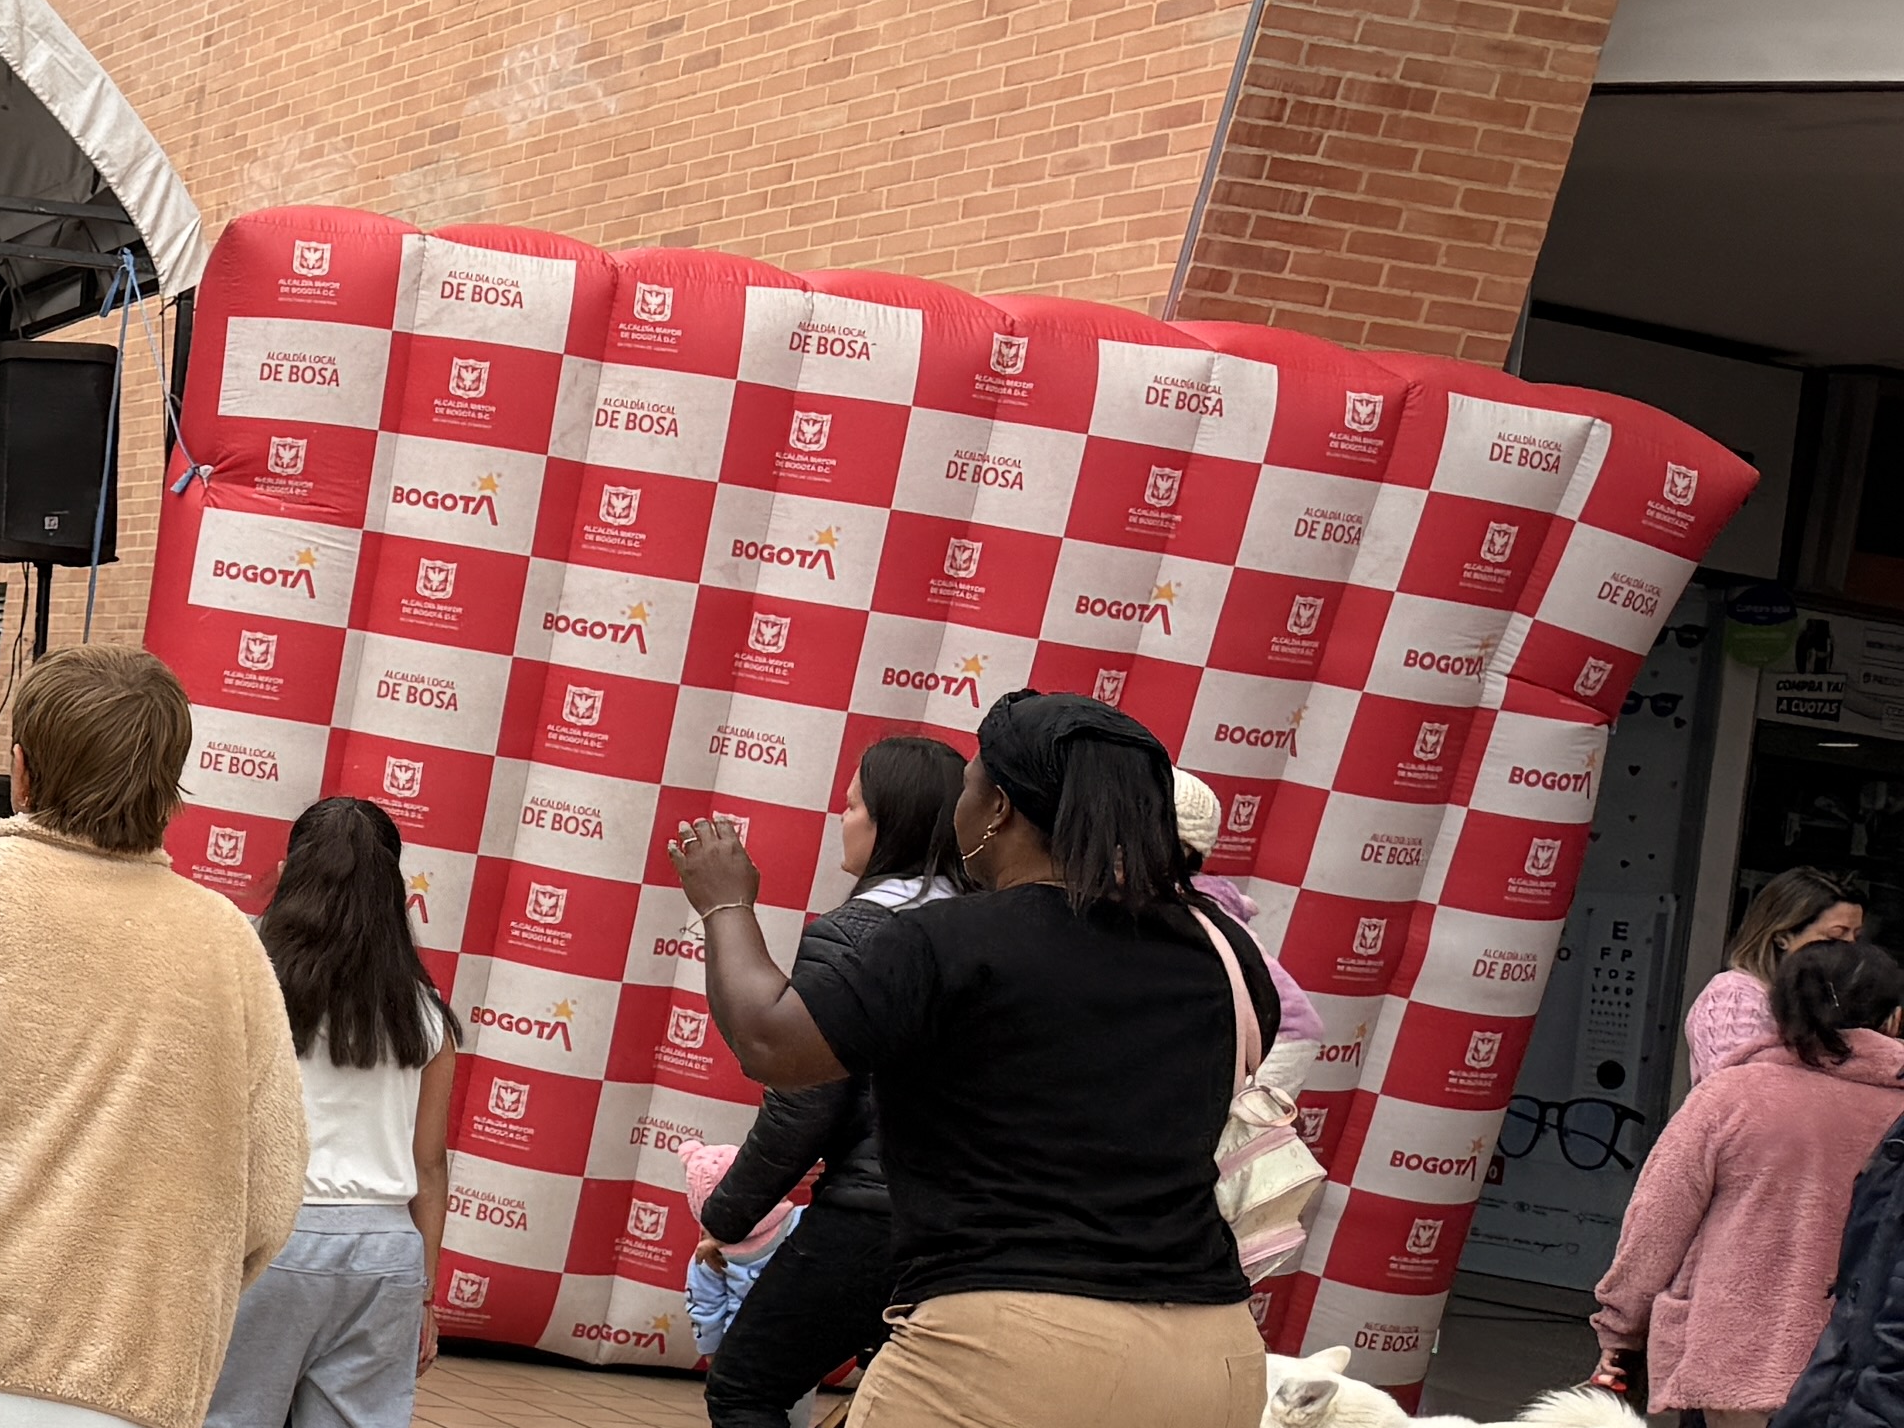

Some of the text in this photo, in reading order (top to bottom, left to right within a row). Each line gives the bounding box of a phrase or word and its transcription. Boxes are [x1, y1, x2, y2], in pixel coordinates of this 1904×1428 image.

[440, 281, 523, 309] DE BOSA
[788, 331, 870, 361] DE BOSA
[259, 362, 339, 387] DE BOSA
[1145, 386, 1223, 417] DE BOSA
[595, 408, 678, 438] DE BOSA
[992, 456, 1021, 469] LOCAL
[1489, 442, 1561, 474] DE BOSA
[946, 460, 1023, 491] DE BOSA
[1294, 518, 1362, 545] DE BOSA
[1597, 581, 1659, 617] DE BOSA
[376, 680, 458, 712] DE BOSA
[427, 678, 455, 690] LOCAL
[709, 735, 788, 767] DE BOSA
[757, 732, 785, 745] LOCAL
[199, 751, 279, 782] DE BOSA
[521, 806, 603, 840] DE BOSA
[572, 806, 601, 818] LOCAL
[1360, 843, 1422, 866] DE BOSA
[1612, 920, 1629, 941] E
[653, 937, 705, 963] BOGO
[1472, 958, 1537, 982] DE BOSA
[629, 1127, 683, 1153] DE BO
[447, 1194, 528, 1231] DE BOSA
[498, 1197, 526, 1210] LOCAL
[1354, 1330, 1419, 1353] DE BOSA
